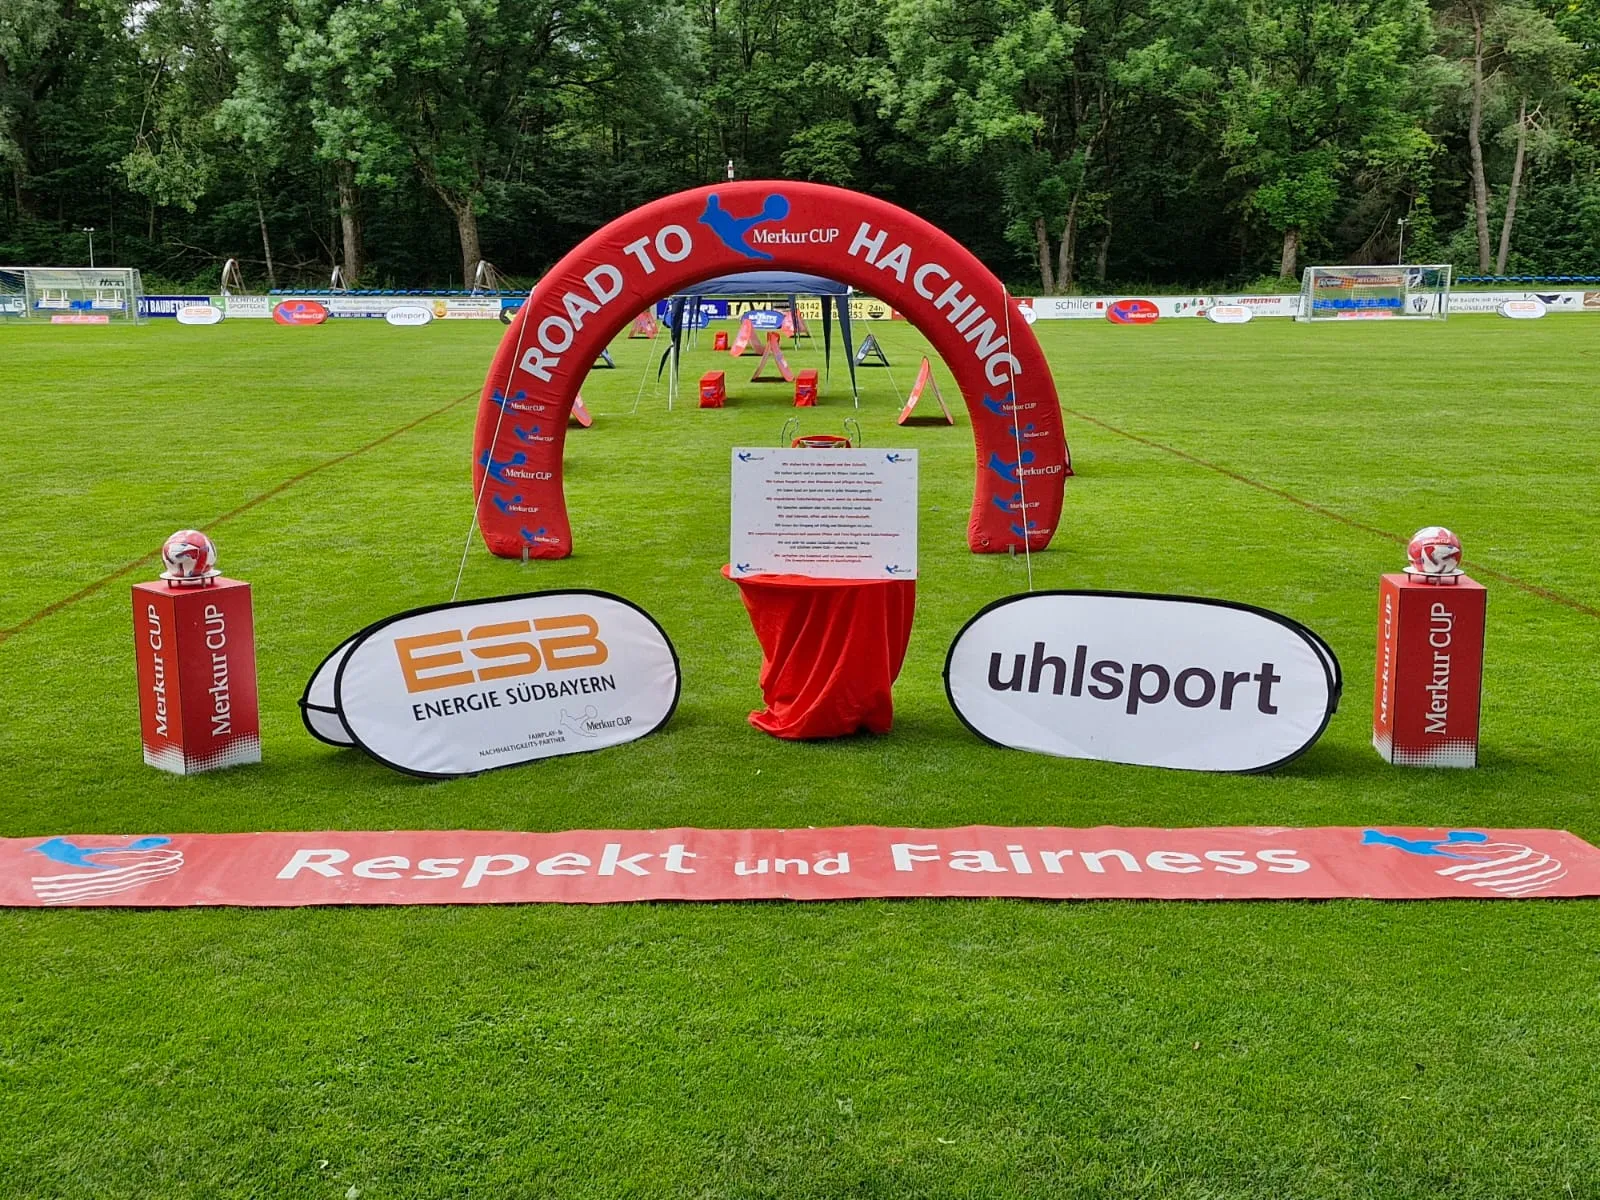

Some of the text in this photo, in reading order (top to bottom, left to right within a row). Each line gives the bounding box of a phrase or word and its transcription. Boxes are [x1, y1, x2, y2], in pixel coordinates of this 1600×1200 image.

[753, 228, 840, 243] Merkur CUP
[391, 312, 426, 321] uhlsport
[519, 224, 693, 382] ROAD TO
[727, 301, 773, 319] TAXI
[847, 221, 1022, 386] HACHING
[868, 303, 884, 312] 24h
[1055, 299, 1095, 310] schiller
[511, 402, 545, 412] Merkur CUP
[505, 468, 552, 481] Merkur CUP
[1016, 464, 1062, 477] Merkur CUP
[147, 604, 168, 737] Merkur CUP
[204, 604, 231, 736] Merkur CUP
[394, 613, 609, 694] ESB
[1380, 593, 1393, 725] Merkur CUP
[1424, 602, 1453, 735] Merkur CUP
[412, 674, 617, 722] ENERGIE SÜDBAYERN
[987, 641, 1282, 716] uhlsport
[586, 715, 632, 731] Merkur CUP
[276, 842, 1311, 890] Respekt und Fairness
